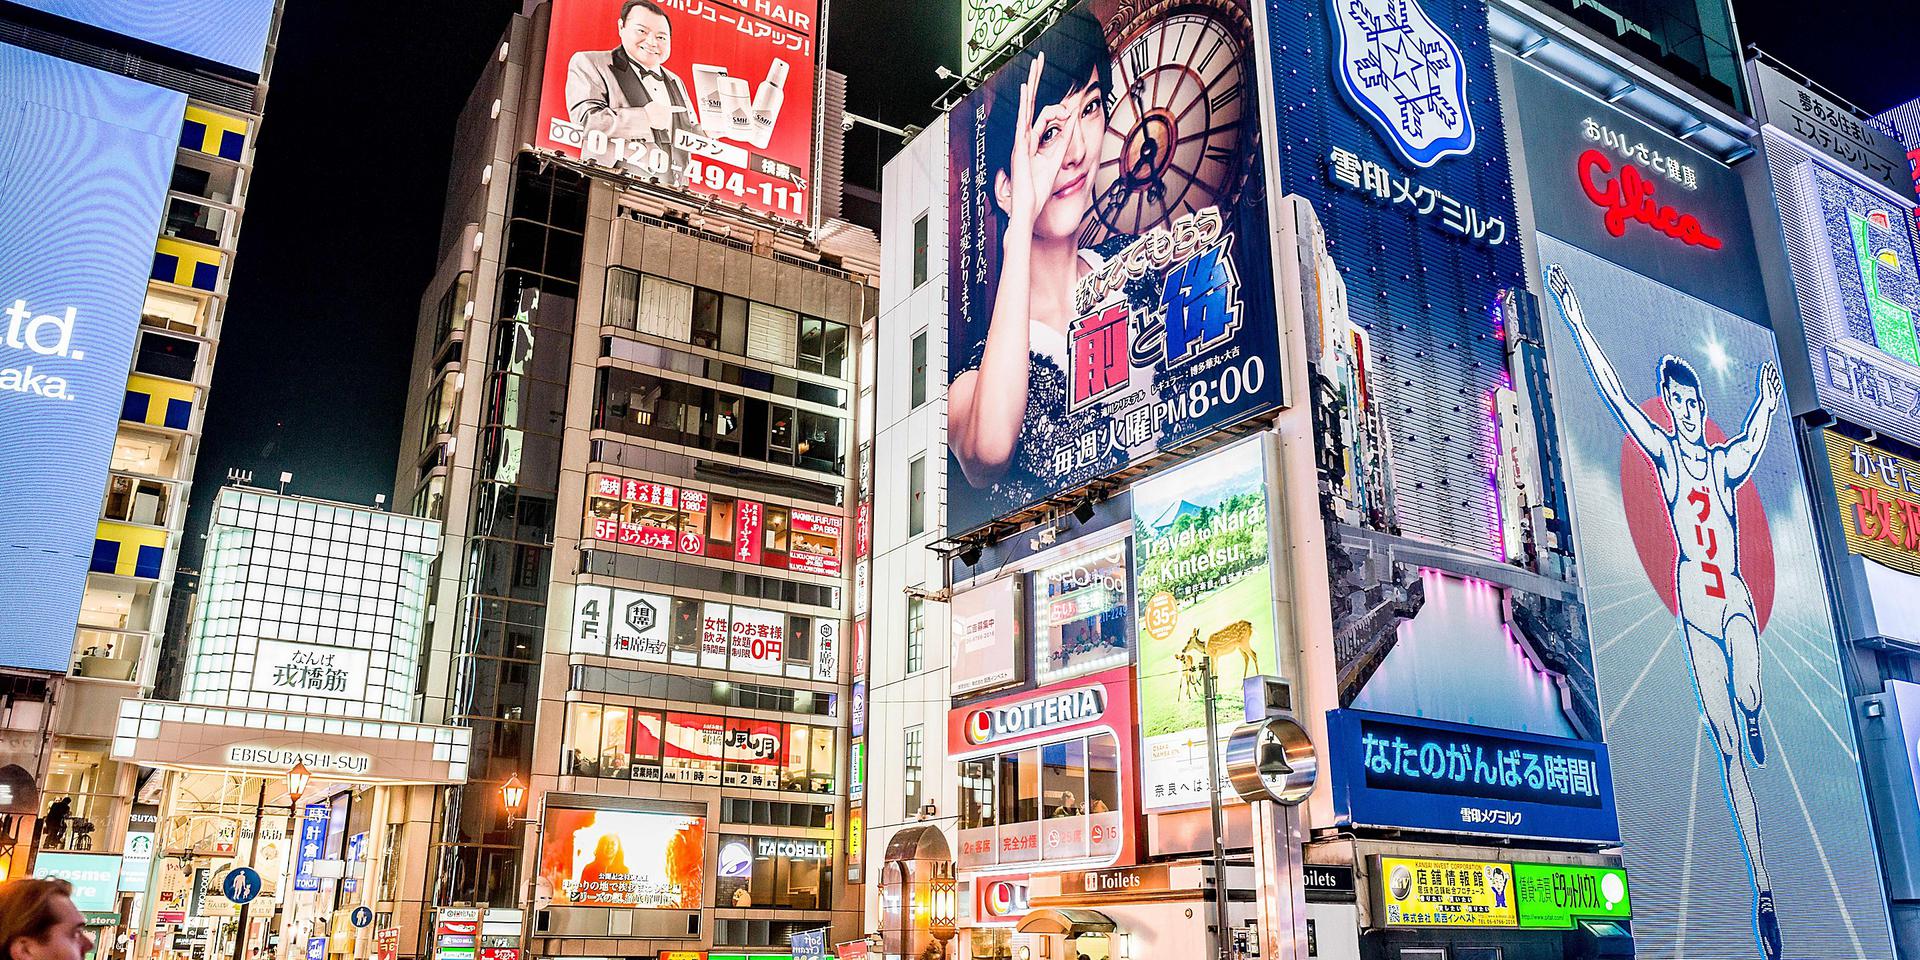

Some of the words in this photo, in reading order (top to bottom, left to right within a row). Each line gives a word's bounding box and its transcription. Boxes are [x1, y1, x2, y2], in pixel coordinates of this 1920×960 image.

[755, 0, 810, 30] HAIR
[1797, 89, 1875, 146] 夢ある住まい
[680, 134, 723, 156] ルアン
[1581, 116, 1698, 191] おいしさと健康
[1791, 114, 1895, 186] エステムシリーズ
[586, 129, 803, 214] 0120-494-111
[761, 158, 790, 180] 検索
[975, 104, 988, 284] 見た目は変わりませんが、
[1330, 145, 1505, 245] 雪印メグミルク
[1578, 149, 1722, 250] Glico
[960, 167, 972, 323] 見る目が変わります。
[1076, 205, 1222, 314] 教えてもらう
[0, 299, 85, 361] td.
[1053, 404, 1152, 477] 毎週火曜
[1152, 355, 1265, 434] PM8:00
[600, 478, 620, 495] 焼肉
[595, 520, 616, 540] 5F
[621, 530, 672, 550] ふうふう亭
[682, 533, 699, 551] ふ
[738, 503, 752, 560] ふうふう亭
[1141, 522, 1196, 560] Travel
[1200, 527, 1211, 541] to
[1208, 505, 1261, 534] Nara
[1687, 486, 1726, 600] グリコ
[1161, 543, 1245, 584] Kintetsu.
[581, 599, 600, 640] 4F
[632, 606, 650, 626] 相席
[1152, 606, 1170, 624] 35
[614, 633, 662, 655] 相席屋
[751, 638, 783, 662] 0円
[292, 650, 336, 668] なんば
[272, 664, 349, 693] 戎橋筋
[995, 689, 1098, 733] LOTTERIA
[724, 727, 775, 760] 風月
[231, 747, 280, 764] EBISU
[283, 750, 368, 773] BASHI-SUJI
[632, 767, 660, 780] 営業時間
[1362, 733, 1600, 797] なたのがんばる時間
[1460, 807, 1522, 826] 雪印メグミルク
[1003, 834, 1037, 851] 完全分煙
[1106, 827, 1117, 840] 15
[36, 866, 113, 884] @cosme
[1303, 870, 1336, 887] oilets
[1417, 868, 1484, 887] 店舗情報館
[1451, 863, 1482, 871] CORPORATION
[1100, 873, 1141, 890] Toilets
[1551, 872, 1601, 909] ピタットハウス
[1402, 913, 1431, 923] 株式会社
[1433, 913, 1476, 924] 関西インベスト
